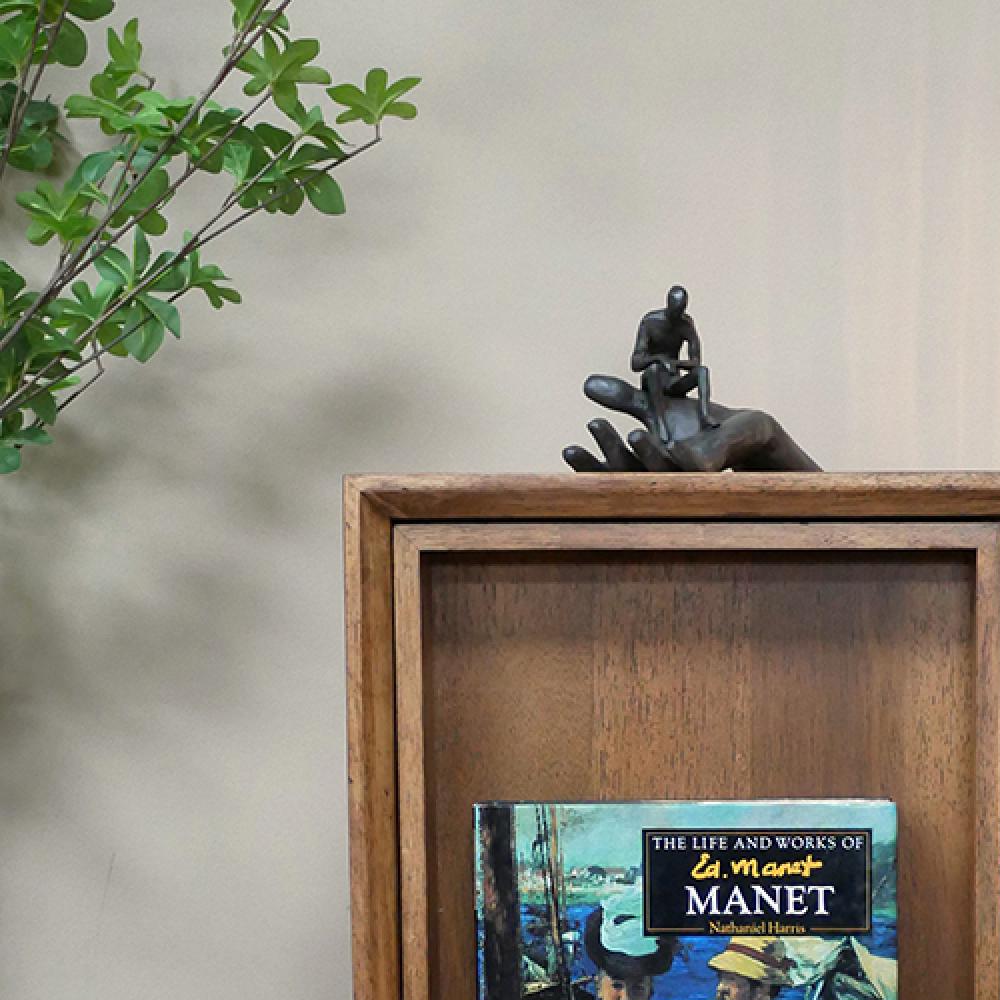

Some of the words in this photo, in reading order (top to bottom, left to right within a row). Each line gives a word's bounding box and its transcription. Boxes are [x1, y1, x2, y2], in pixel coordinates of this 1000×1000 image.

[652, 836, 686, 850] THE
[692, 836, 729, 850] LIFE
[733, 836, 772, 850] AND
[775, 836, 837, 850] WORKS
[841, 836, 864, 850] OF
[684, 885, 836, 915] MANET
[709, 921, 766, 934] Nathaniel
[767, 921, 806, 934] Harris
